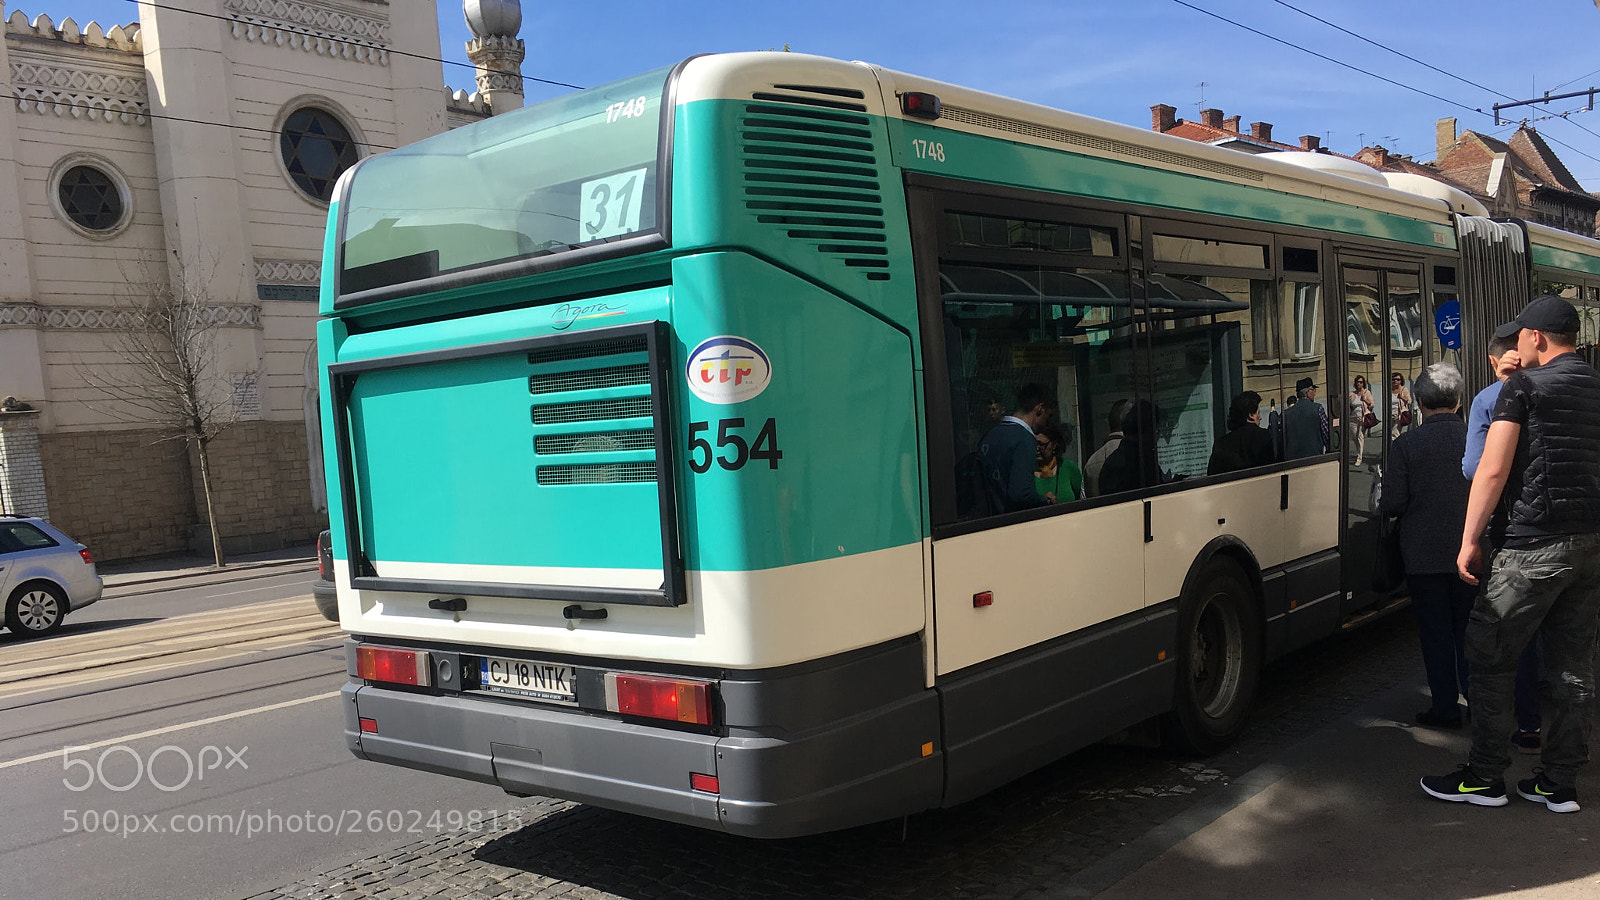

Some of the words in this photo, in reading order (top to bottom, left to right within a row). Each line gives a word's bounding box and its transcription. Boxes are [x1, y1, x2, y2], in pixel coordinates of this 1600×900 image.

[606, 96, 646, 124] 1748
[912, 138, 946, 163] 1748
[585, 175, 637, 235] 31
[551, 303, 629, 331] Agora
[687, 417, 783, 474] 554
[491, 660, 510, 684] CJ
[514, 662, 530, 687] 18
[533, 664, 567, 691] NTK
